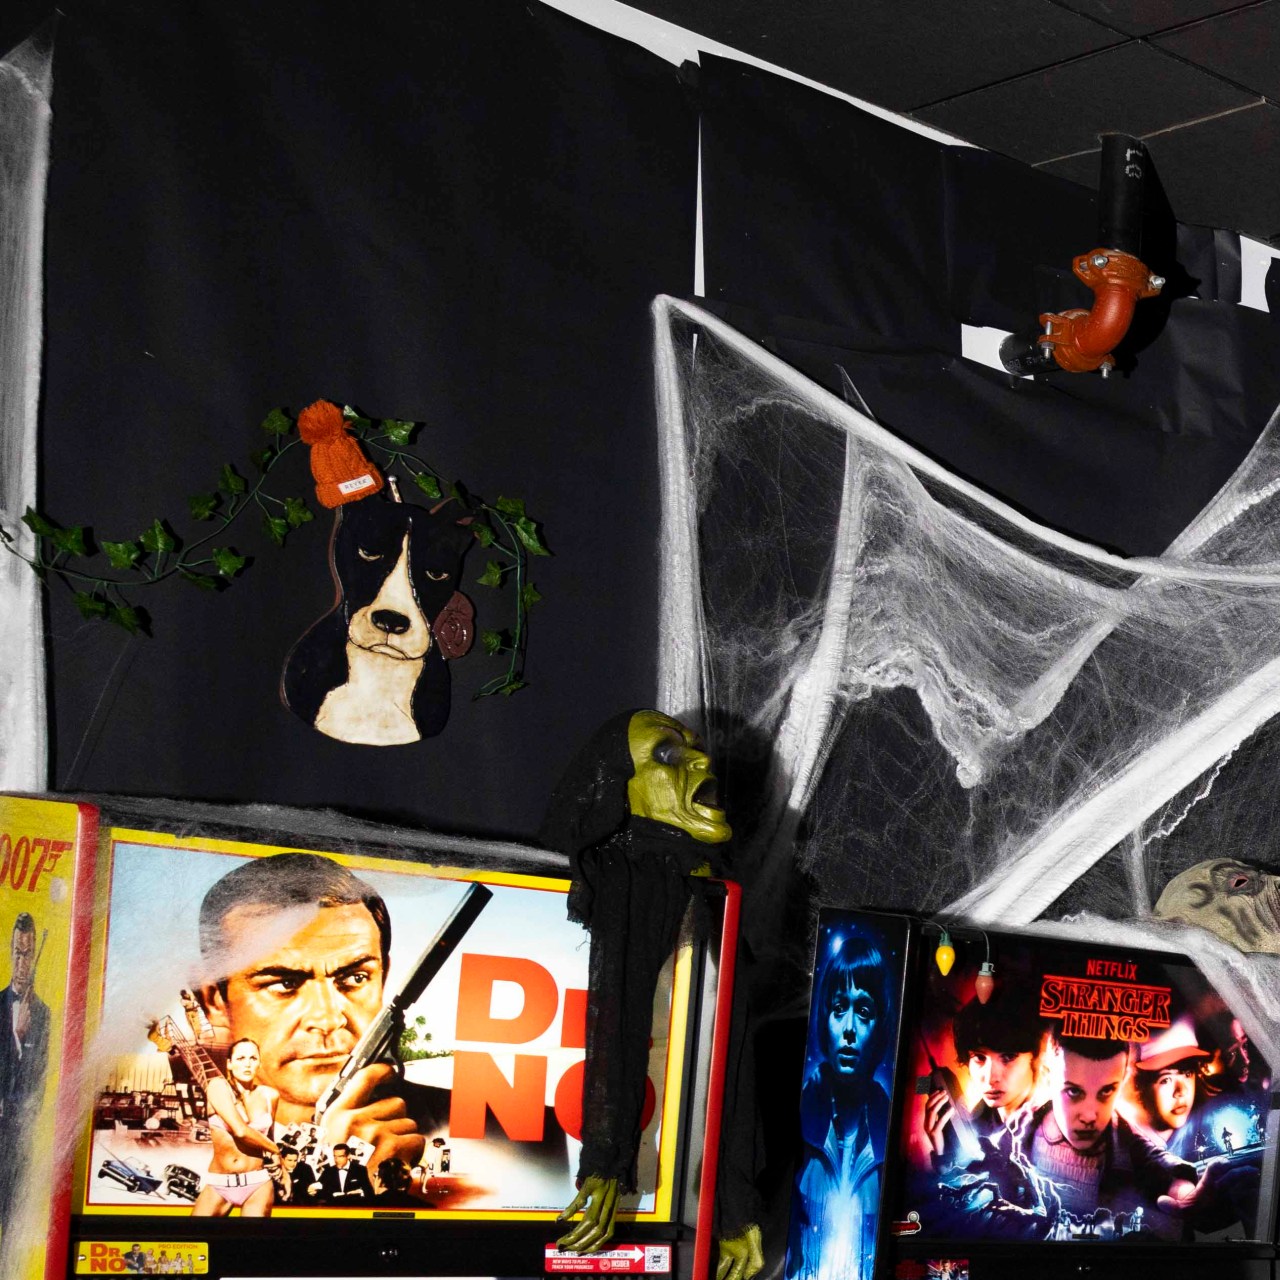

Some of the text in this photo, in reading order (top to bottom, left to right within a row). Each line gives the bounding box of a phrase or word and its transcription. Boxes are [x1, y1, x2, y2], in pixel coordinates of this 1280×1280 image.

[1087, 959, 1137, 980] NETFLIX
[1040, 980, 1171, 1023] STRANGER
[1061, 1011, 1150, 1042] THINGS
[90, 1259, 126, 1272] NO
